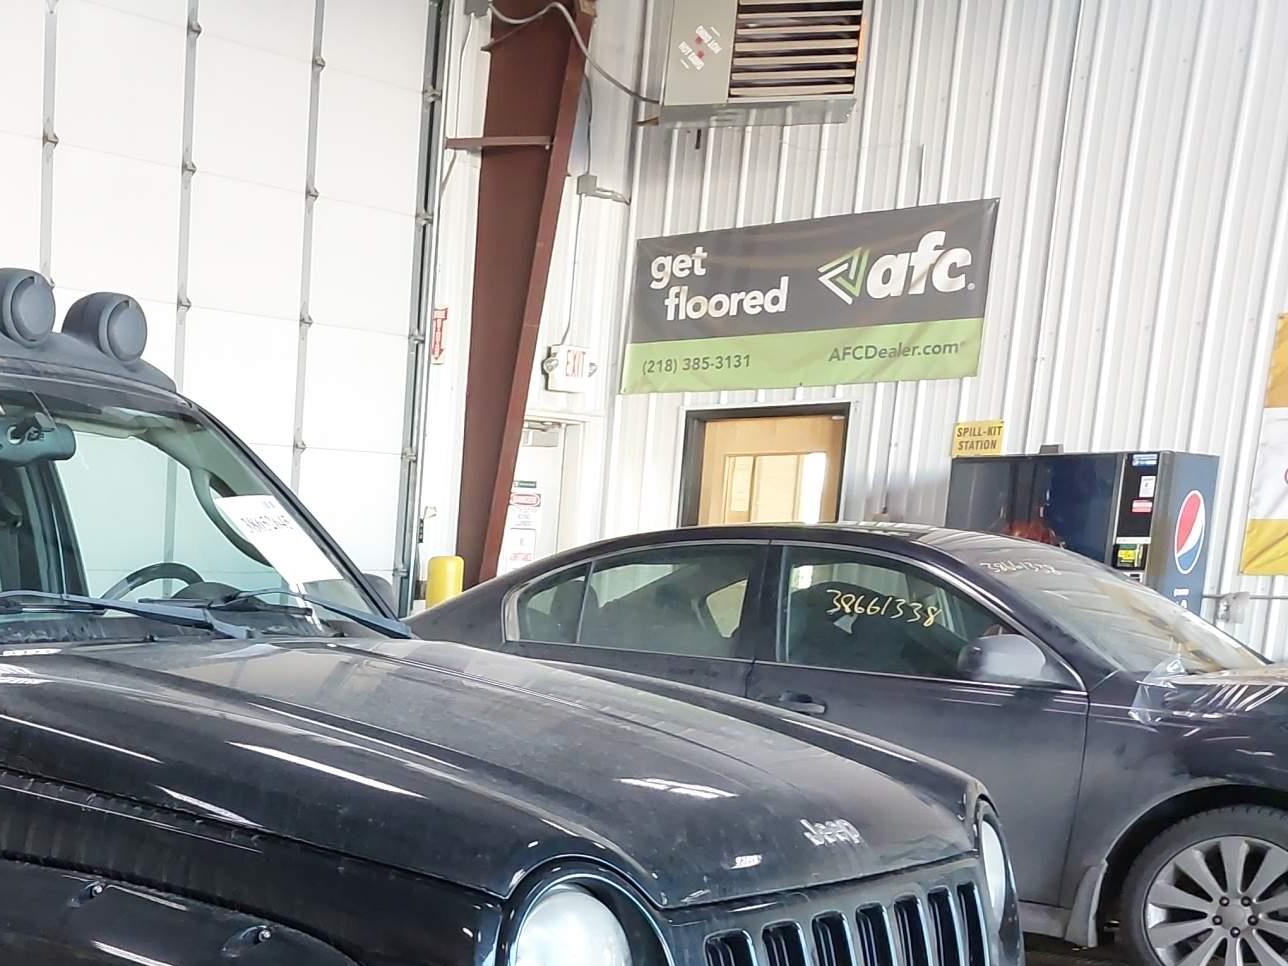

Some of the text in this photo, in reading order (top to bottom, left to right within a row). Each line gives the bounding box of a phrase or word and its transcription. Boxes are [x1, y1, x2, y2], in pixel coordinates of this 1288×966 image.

[650, 246, 708, 289] get
[866, 230, 972, 299] afc
[664, 276, 790, 321] floored
[565, 350, 586, 378] EXIT
[642, 354, 751, 376] (218) 385-3131
[827, 341, 959, 362] AFCDealer.com
[956, 425, 1003, 438] SPILL-KIT
[957, 439, 997, 451] STATION
[826, 588, 944, 628] 38661338
